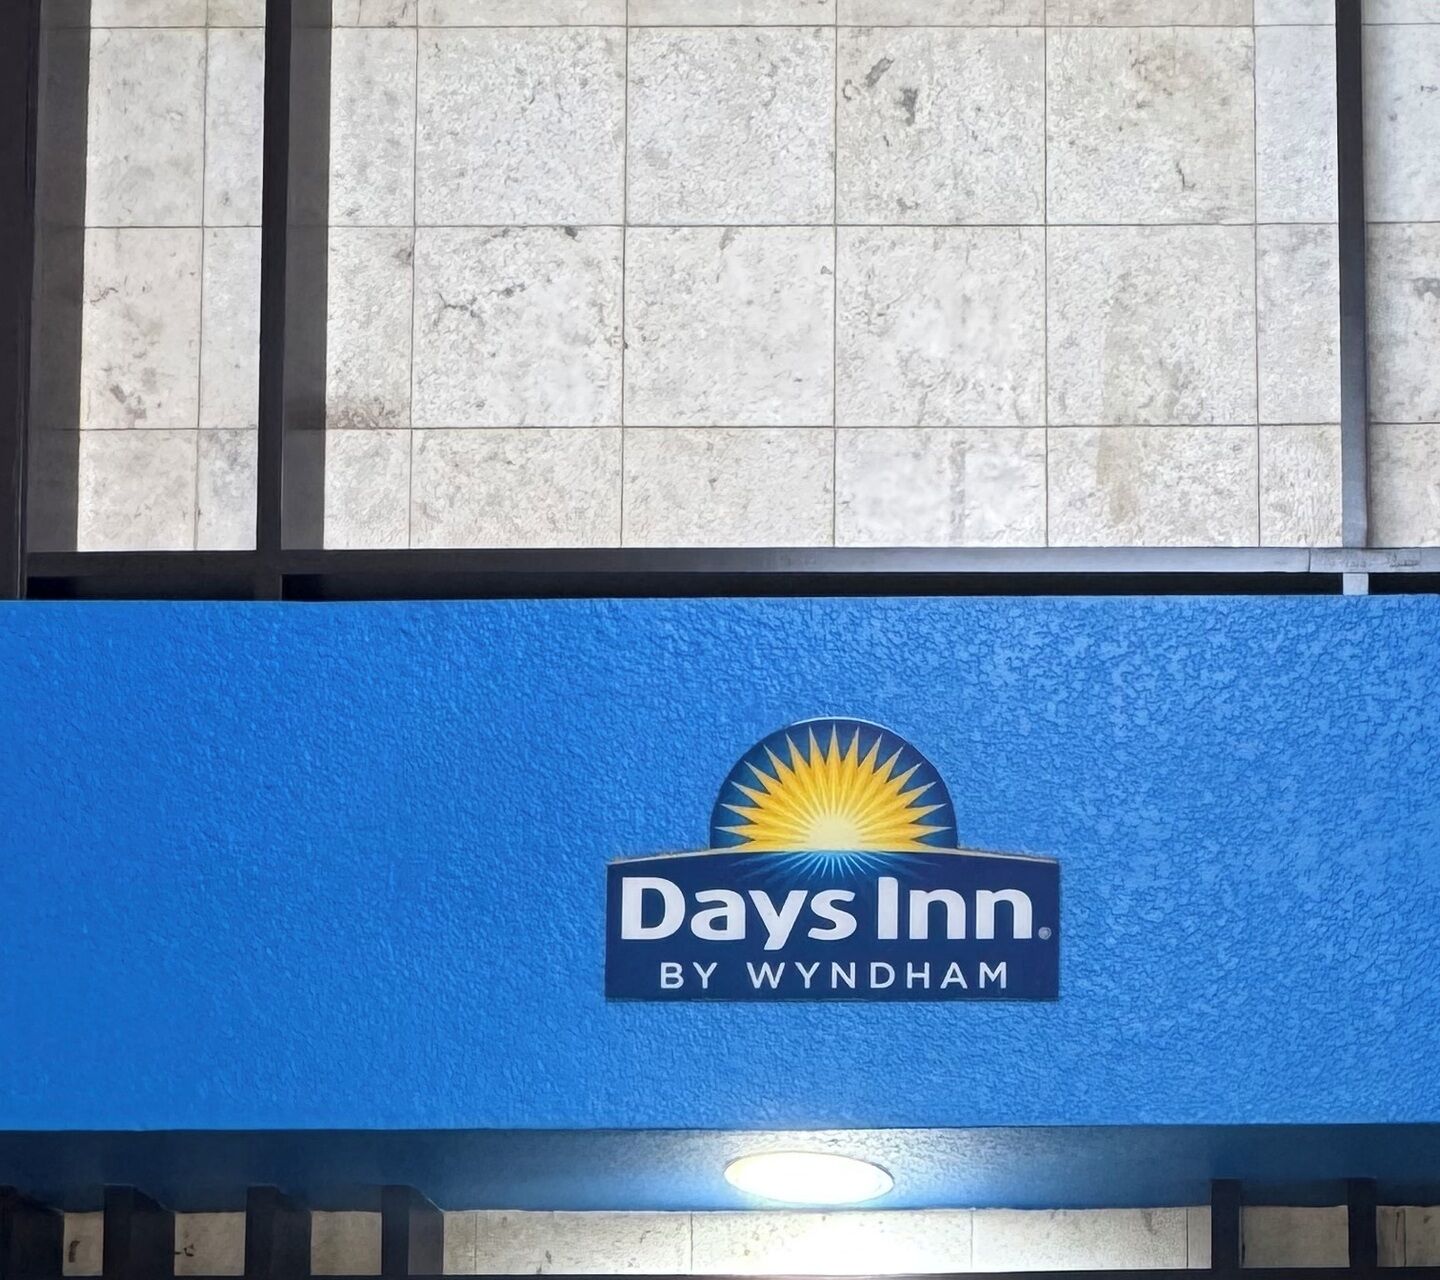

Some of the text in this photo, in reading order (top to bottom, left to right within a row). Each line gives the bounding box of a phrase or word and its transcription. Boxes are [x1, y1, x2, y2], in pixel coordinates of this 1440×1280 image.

[621, 876, 1033, 951] Days Inn
[659, 961, 1008, 990] BY WYNDHAM
